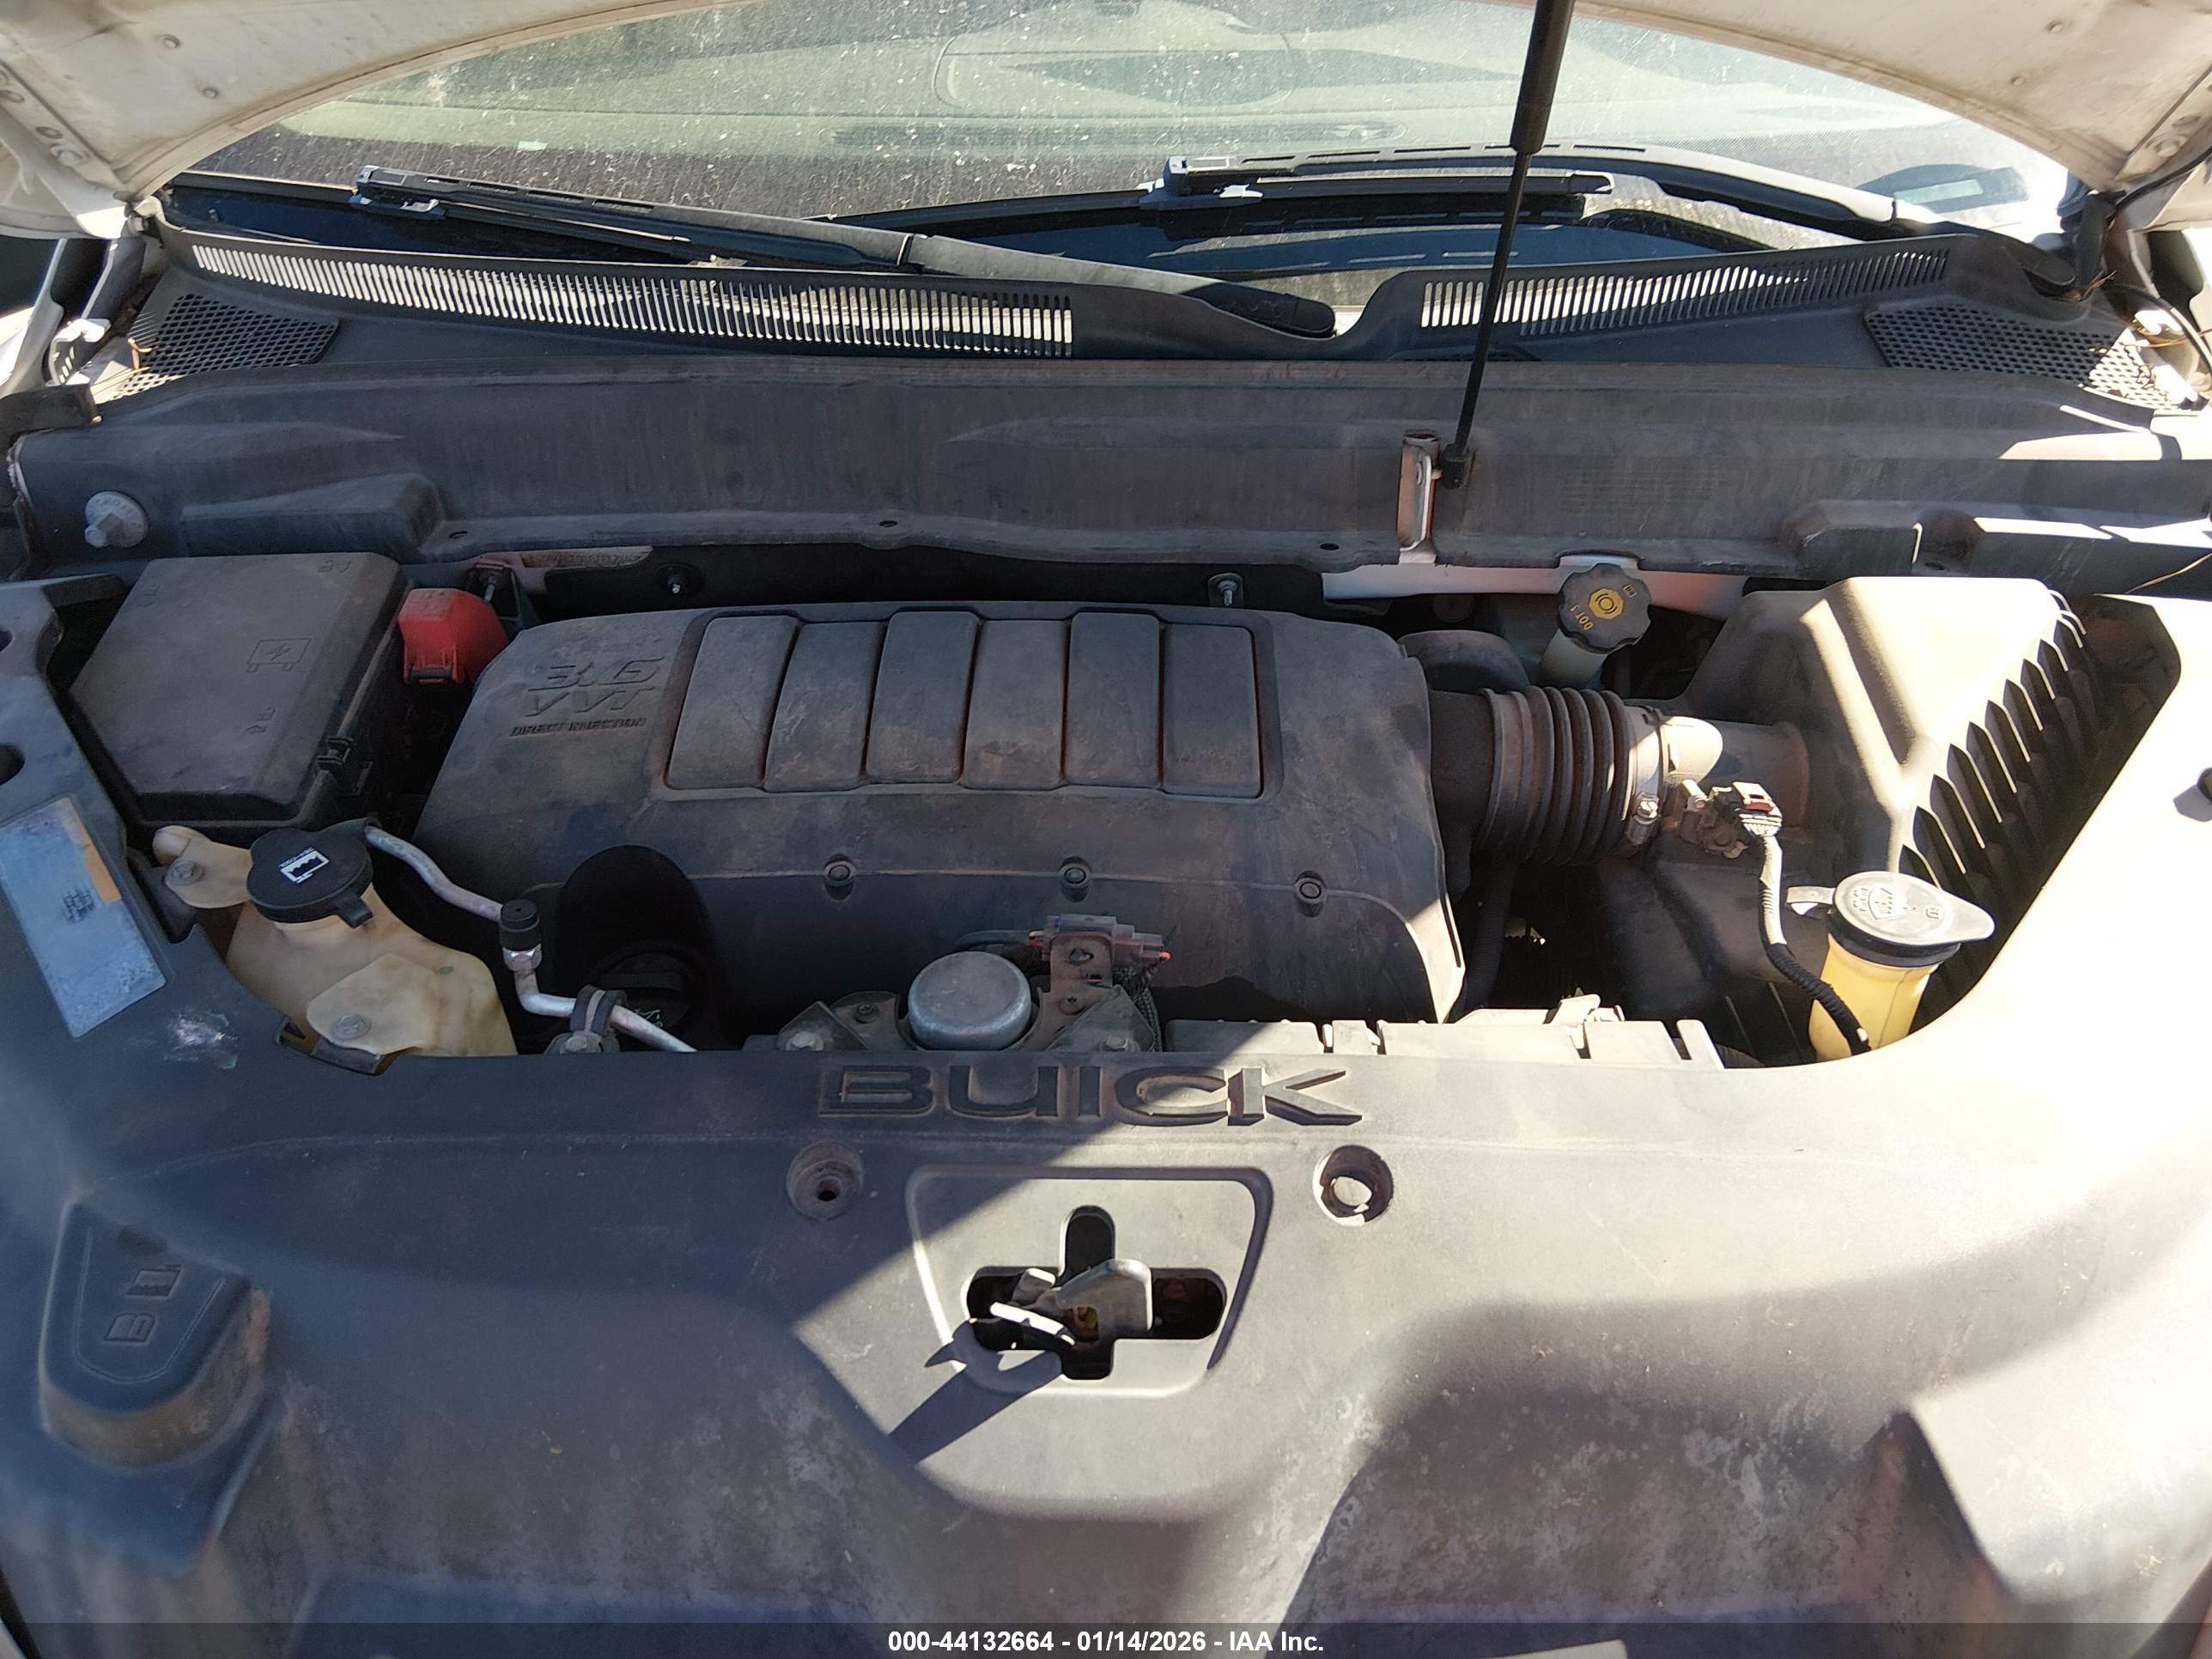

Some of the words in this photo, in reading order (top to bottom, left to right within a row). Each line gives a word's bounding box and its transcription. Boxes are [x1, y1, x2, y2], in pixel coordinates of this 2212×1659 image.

[1575, 611, 1594, 631] DOT
[527, 656, 665, 692] 3.6
[524, 685, 656, 718] VVT
[822, 1066, 1363, 1126] BUICK
